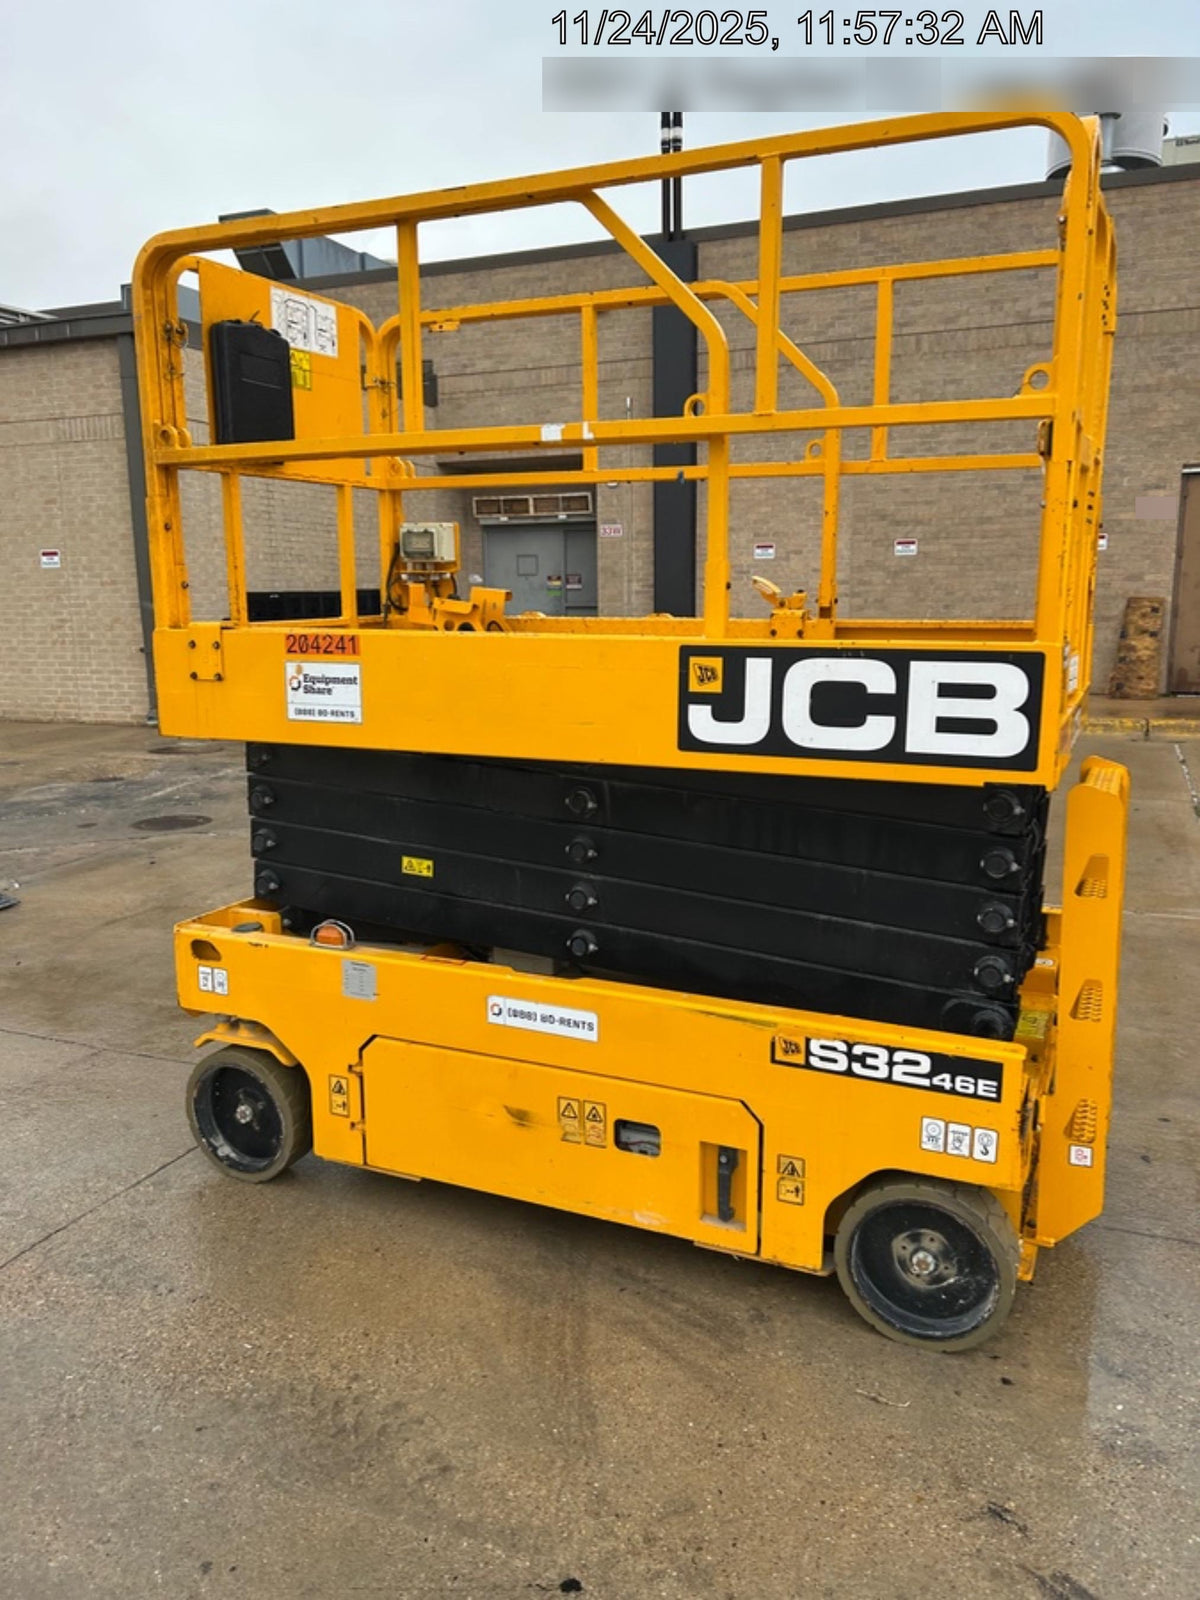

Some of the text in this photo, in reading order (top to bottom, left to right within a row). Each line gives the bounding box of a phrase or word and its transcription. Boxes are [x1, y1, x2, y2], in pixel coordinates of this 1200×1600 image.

[286, 634, 358, 655] 204241
[303, 673, 359, 686] Equipment
[693, 663, 719, 686] JCB
[302, 684, 333, 696] Share
[687, 656, 1030, 758] JCB
